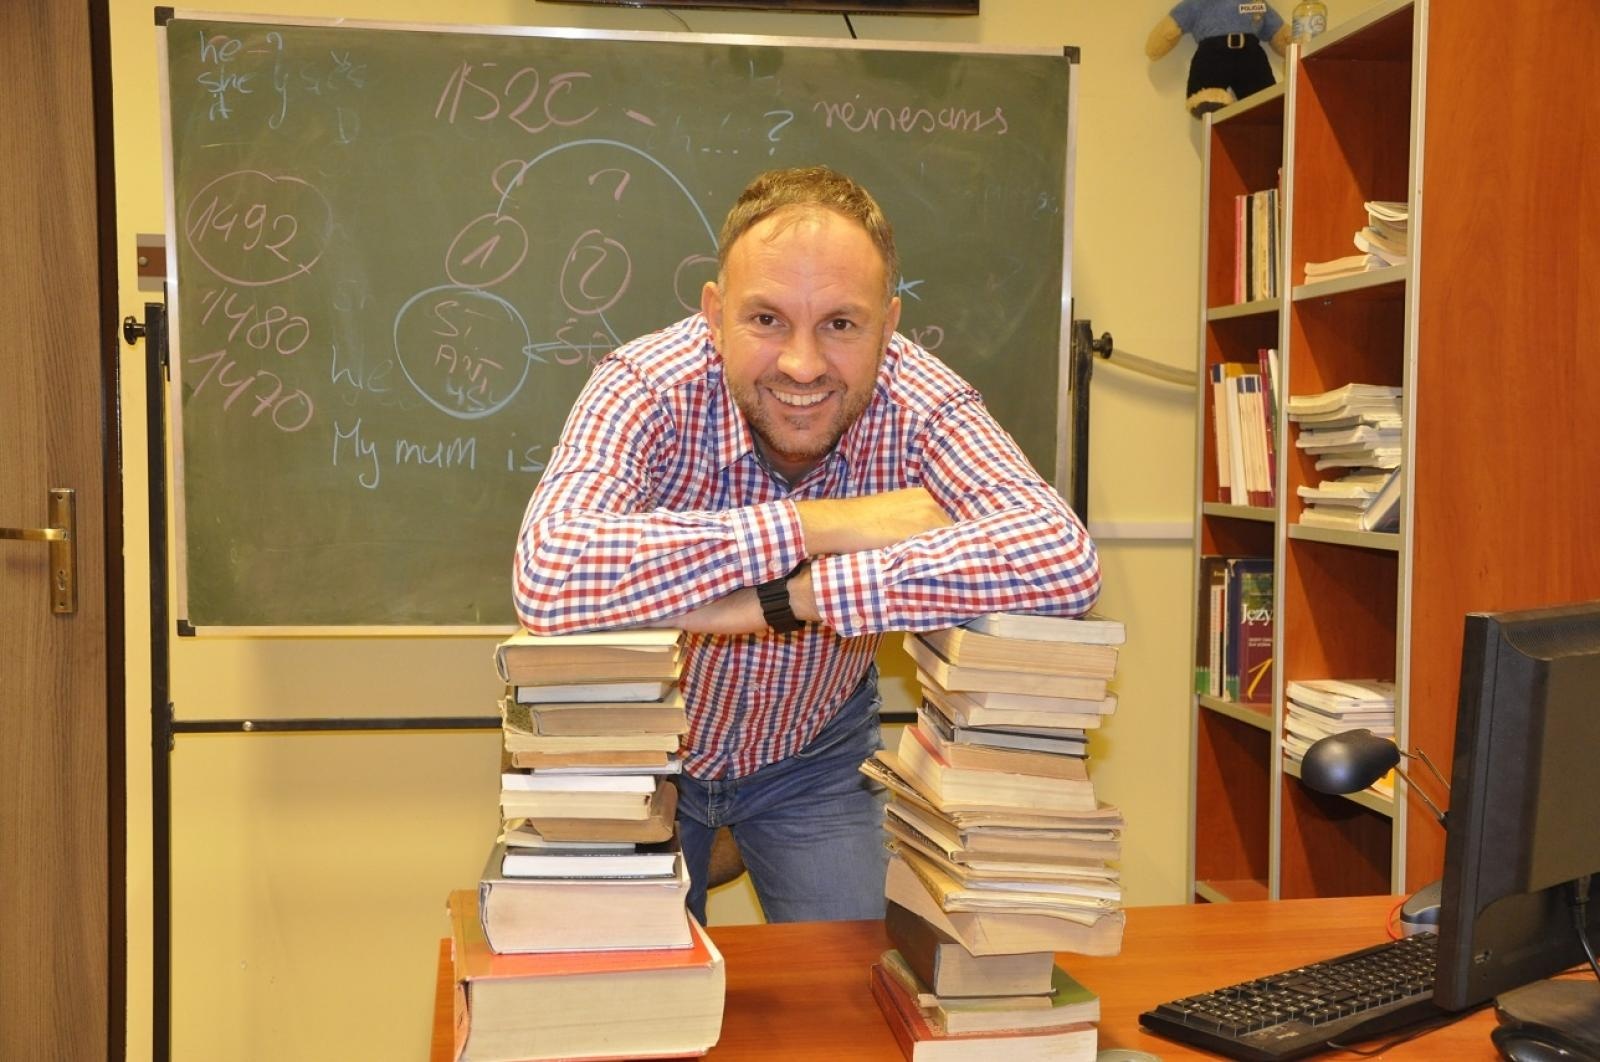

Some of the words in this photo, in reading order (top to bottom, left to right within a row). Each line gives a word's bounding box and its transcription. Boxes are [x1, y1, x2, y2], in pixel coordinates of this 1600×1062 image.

[188, 196, 298, 262] 1492
[202, 287, 310, 355] 1480
[187, 350, 314, 432] 1470
[333, 417, 380, 489] My
[396, 437, 477, 470] mum
[507, 432, 546, 472] is
[1240, 603, 1273, 626] Języ
